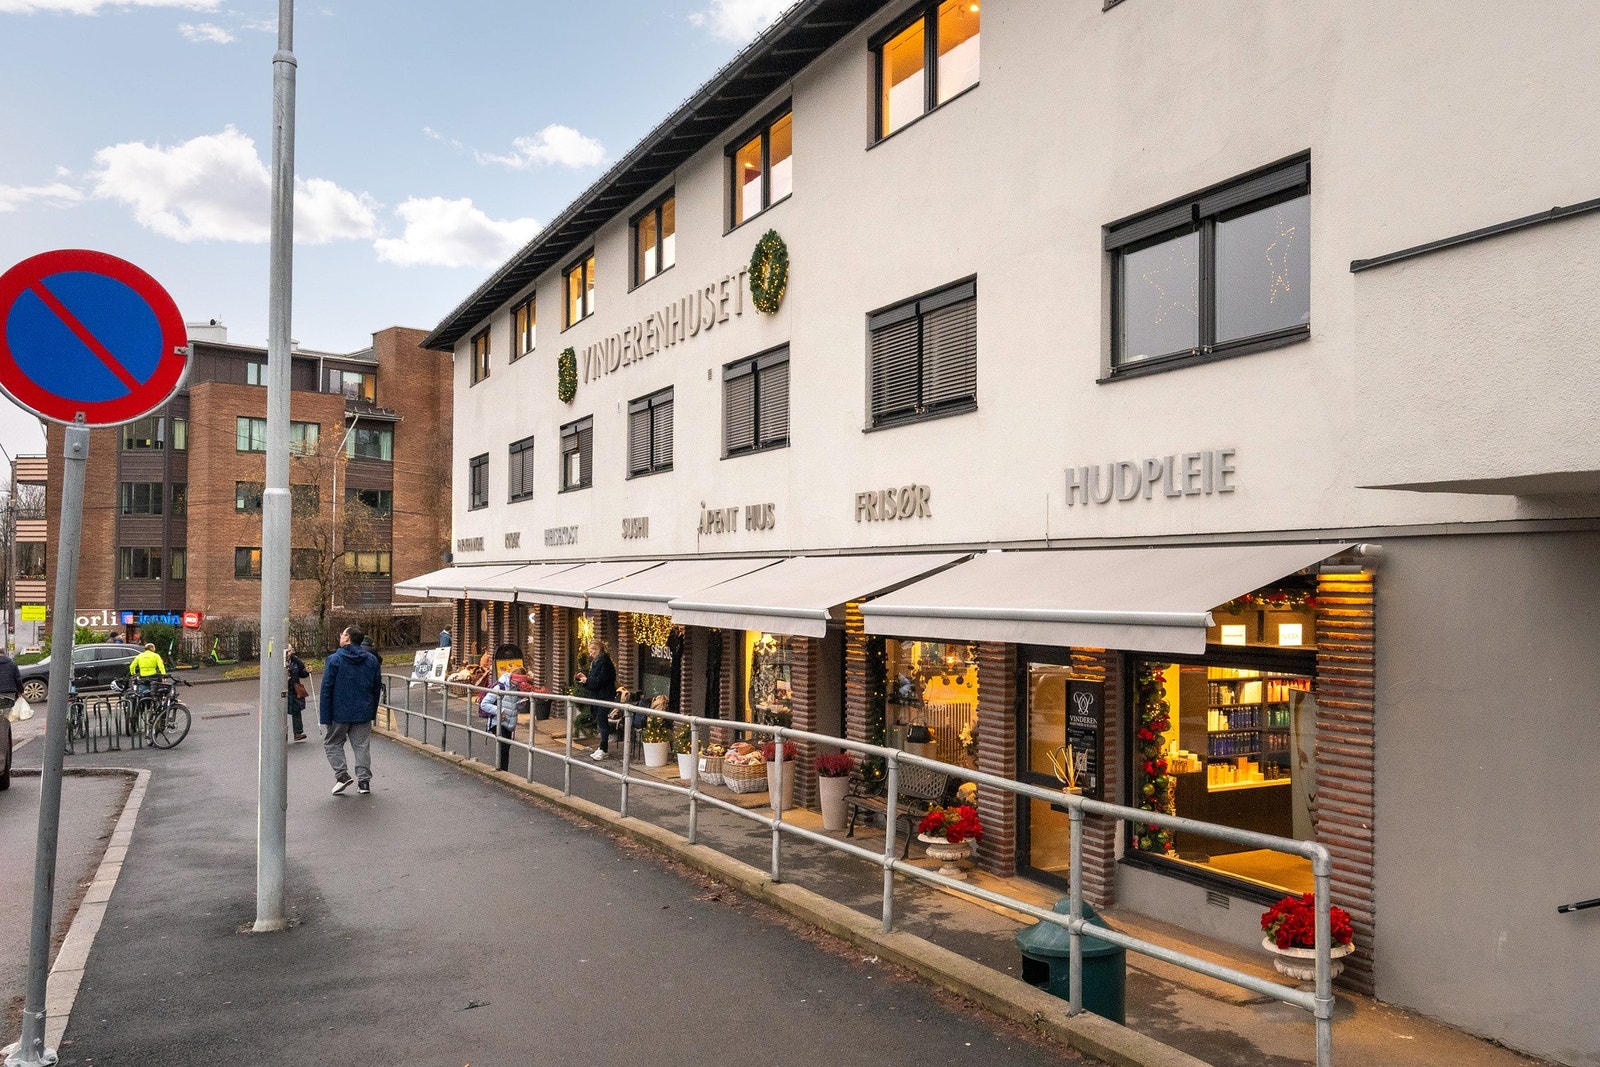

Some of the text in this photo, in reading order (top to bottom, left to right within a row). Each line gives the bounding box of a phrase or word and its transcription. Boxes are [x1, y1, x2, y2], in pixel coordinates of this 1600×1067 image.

[582, 265, 747, 384] VINDERENHUSET
[1065, 448, 1236, 506] HUDPLEIE
[698, 501, 775, 535] ÅPENT HUS
[854, 483, 932, 522] FRISØR
[621, 516, 649, 540] SUSHI
[75, 610, 119, 627] orli
[1069, 714, 1098, 725] VINDEREN
